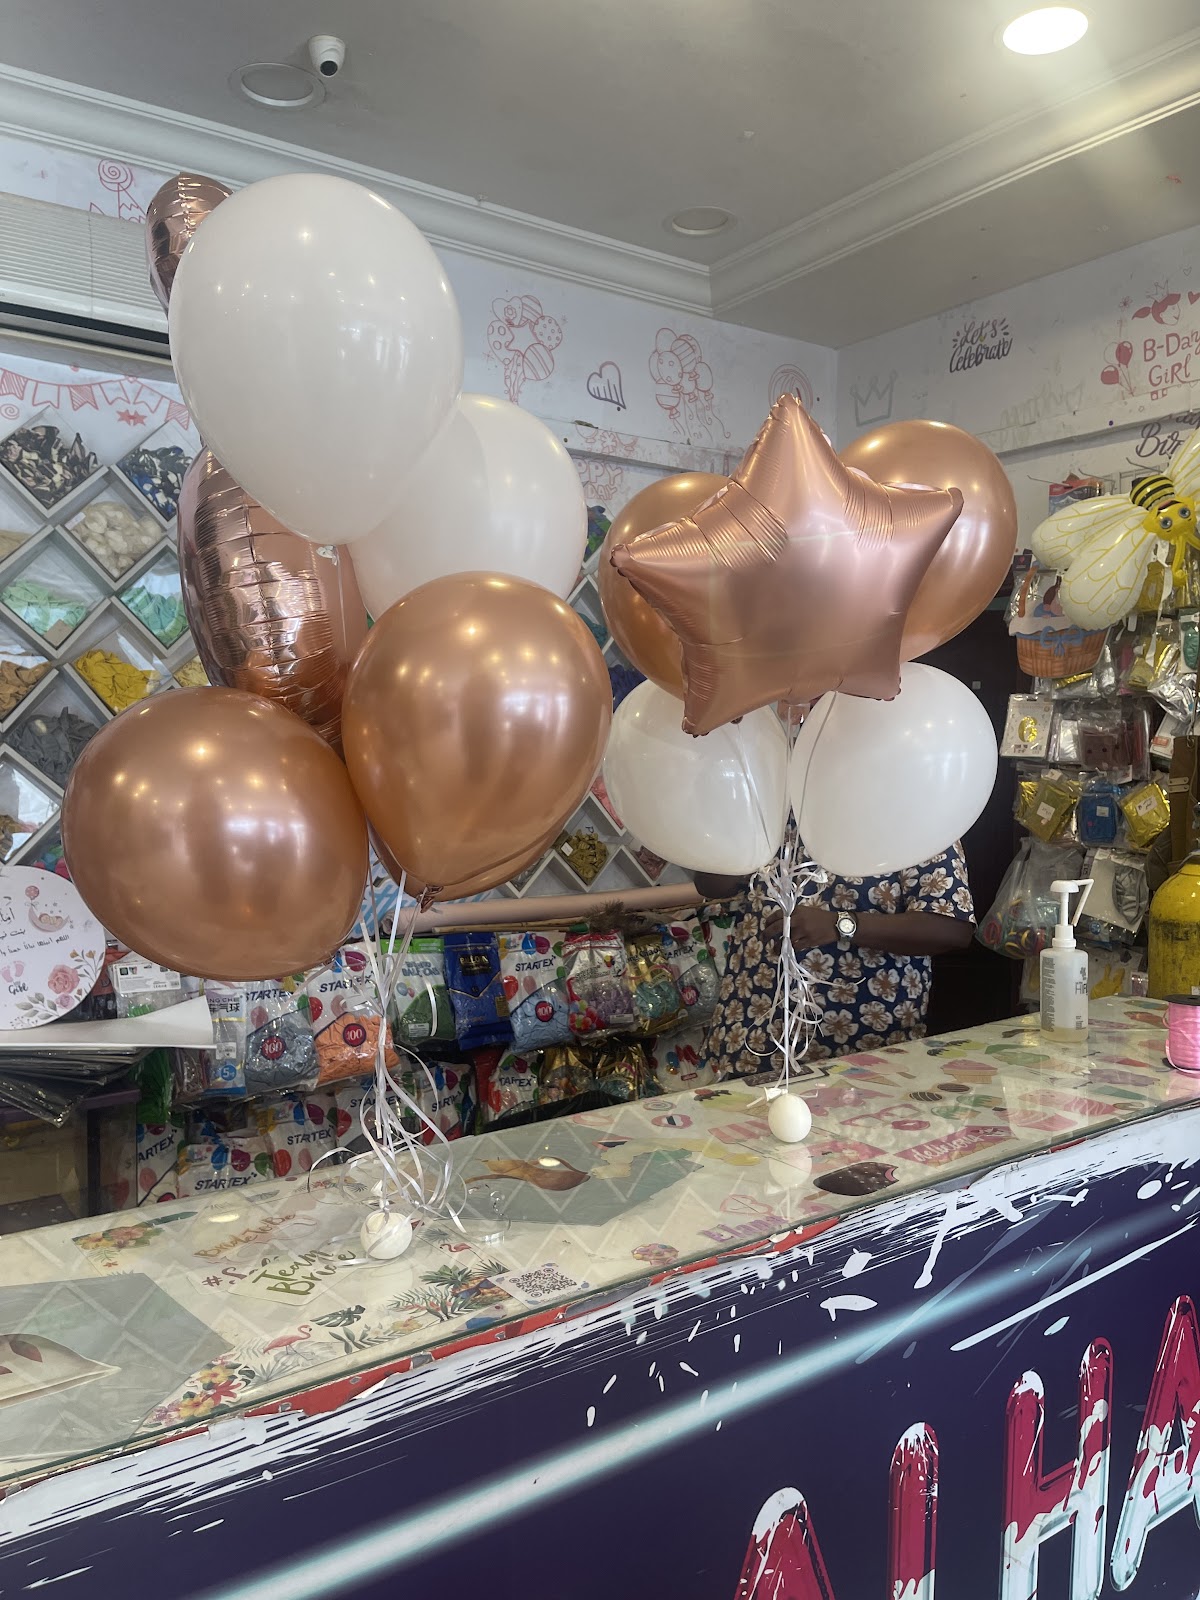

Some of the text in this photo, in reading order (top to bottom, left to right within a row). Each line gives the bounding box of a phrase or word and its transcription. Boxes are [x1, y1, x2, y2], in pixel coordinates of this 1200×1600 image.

[959, 319, 998, 348] Let's
[949, 337, 1013, 373] Celebrate
[514, 958, 554, 972] STARTEX
[346, 1028, 363, 1041] 100
[264, 1041, 283, 1055] 100
[286, 1130, 332, 1146] STARTEX
[137, 1134, 176, 1163] ARTEX
[194, 1175, 251, 1191] STARTEX
